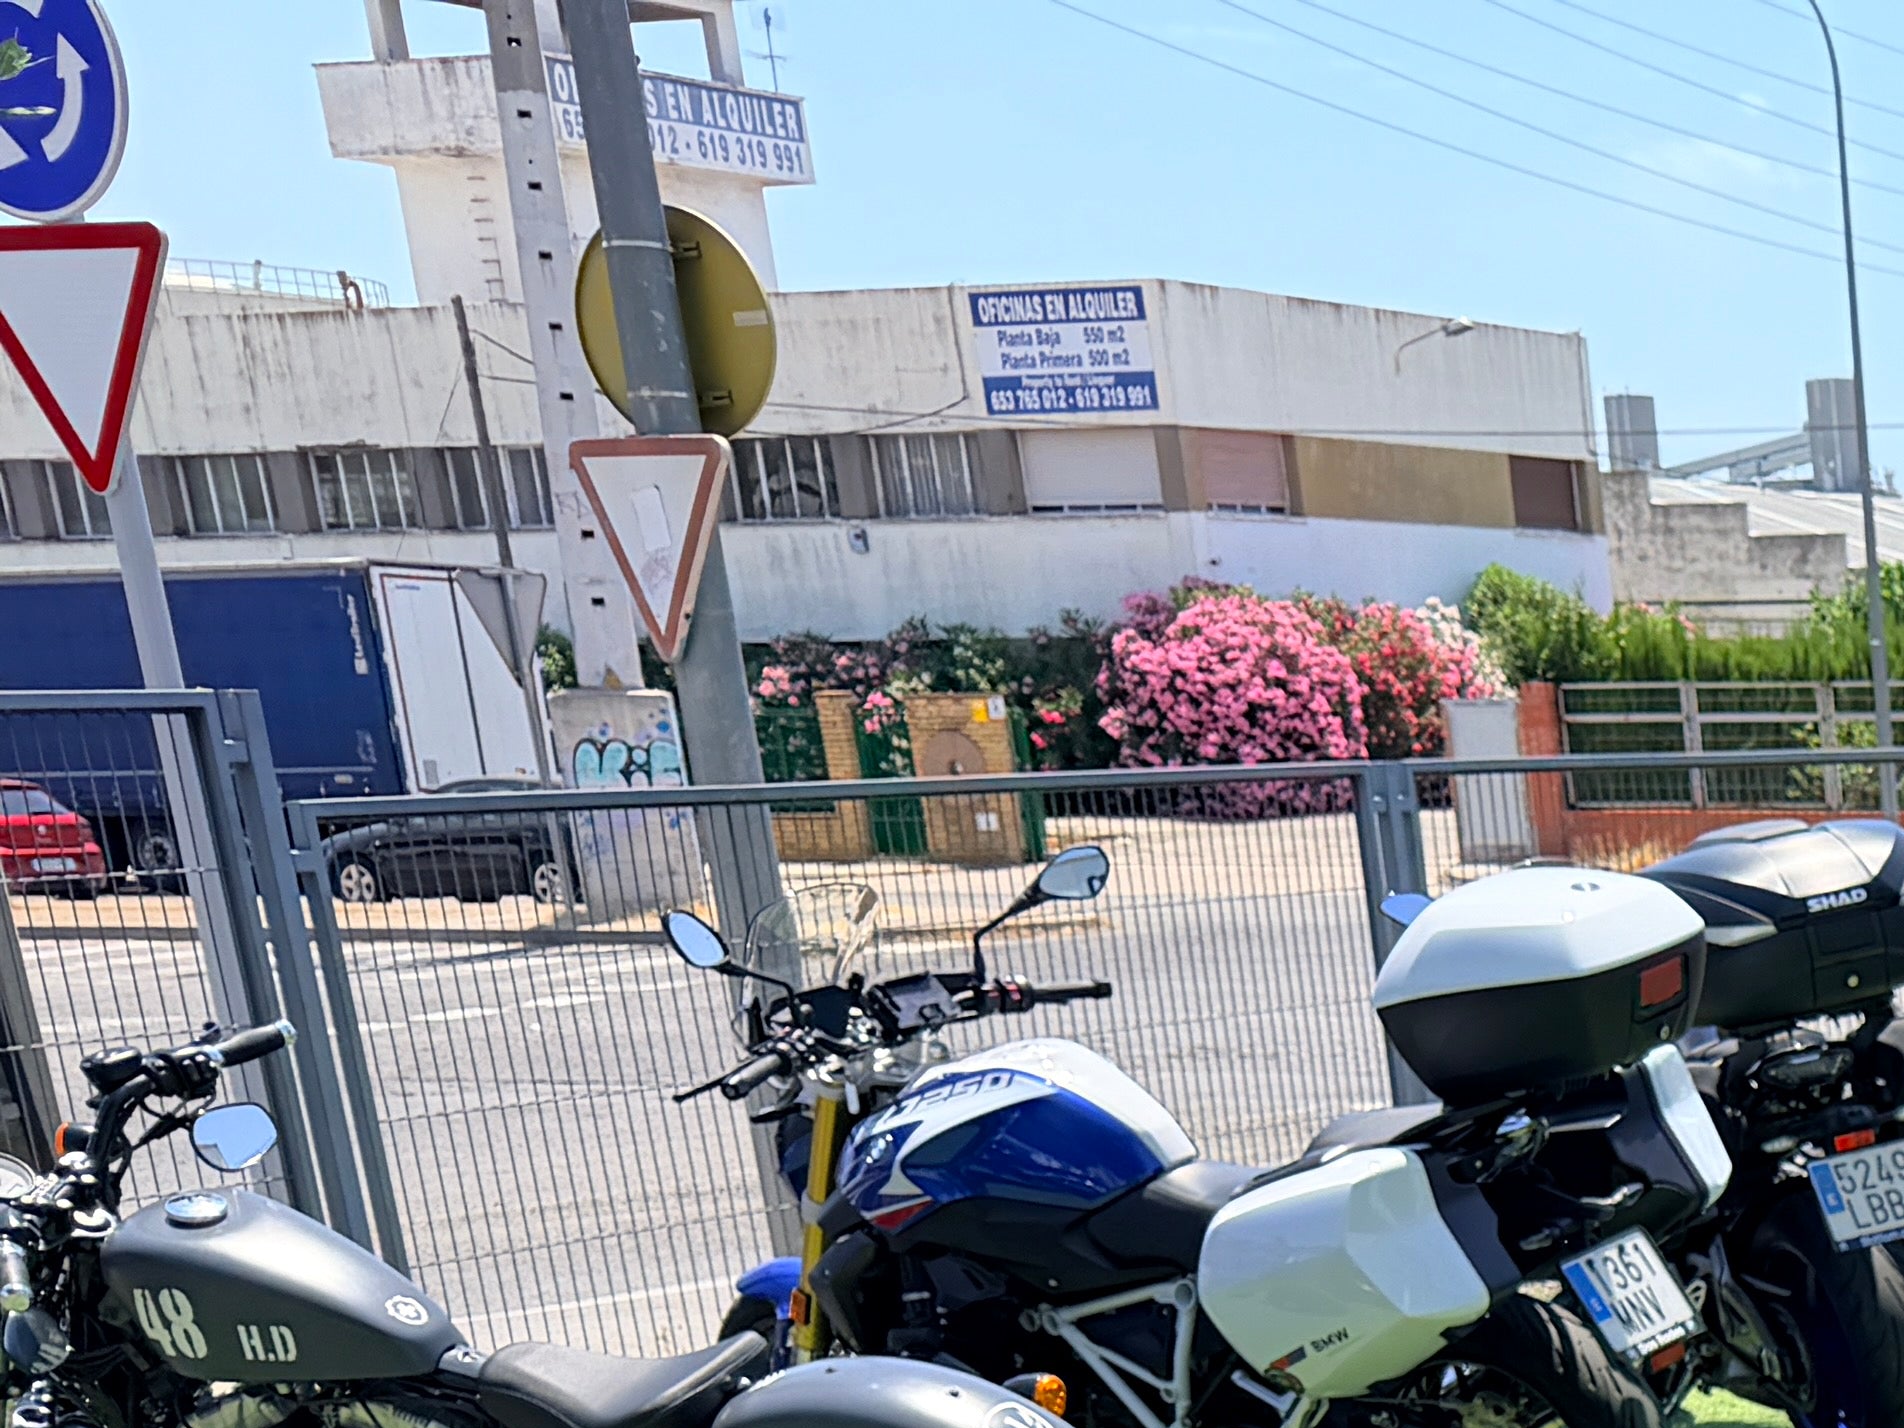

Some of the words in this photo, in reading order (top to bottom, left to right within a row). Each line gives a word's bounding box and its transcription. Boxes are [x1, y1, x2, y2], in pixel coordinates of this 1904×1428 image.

[665, 83, 693, 122] EN
[702, 90, 799, 140] ALQUILER
[697, 130, 729, 162] 619
[737, 137, 767, 168] 319
[775, 144, 803, 174] 991
[978, 294, 1043, 323] OFICINAS
[1045, 293, 1066, 320] EN
[1069, 291, 1138, 320] ALQUILER
[997, 330, 1032, 347] Planta
[1035, 328, 1060, 348] Baja
[1083, 326, 1105, 343] 550
[1107, 325, 1125, 343] m2
[1001, 353, 1036, 370] Planta
[1039, 351, 1083, 369] Primera
[1088, 349, 1109, 366] 500
[1112, 349, 1130, 366] m2
[991, 390, 1014, 411] 653
[1042, 388, 1068, 408] 012
[1075, 388, 1099, 408] 619
[1101, 386, 1126, 407] 319
[1127, 385, 1152, 406] 991
[1807, 887, 1868, 913] SHAD
[1586, 1243, 1656, 1297] 1361
[133, 1288, 208, 1360] 48
[237, 1324, 297, 1361] H.D
[1310, 1327, 1349, 1353] BMW
